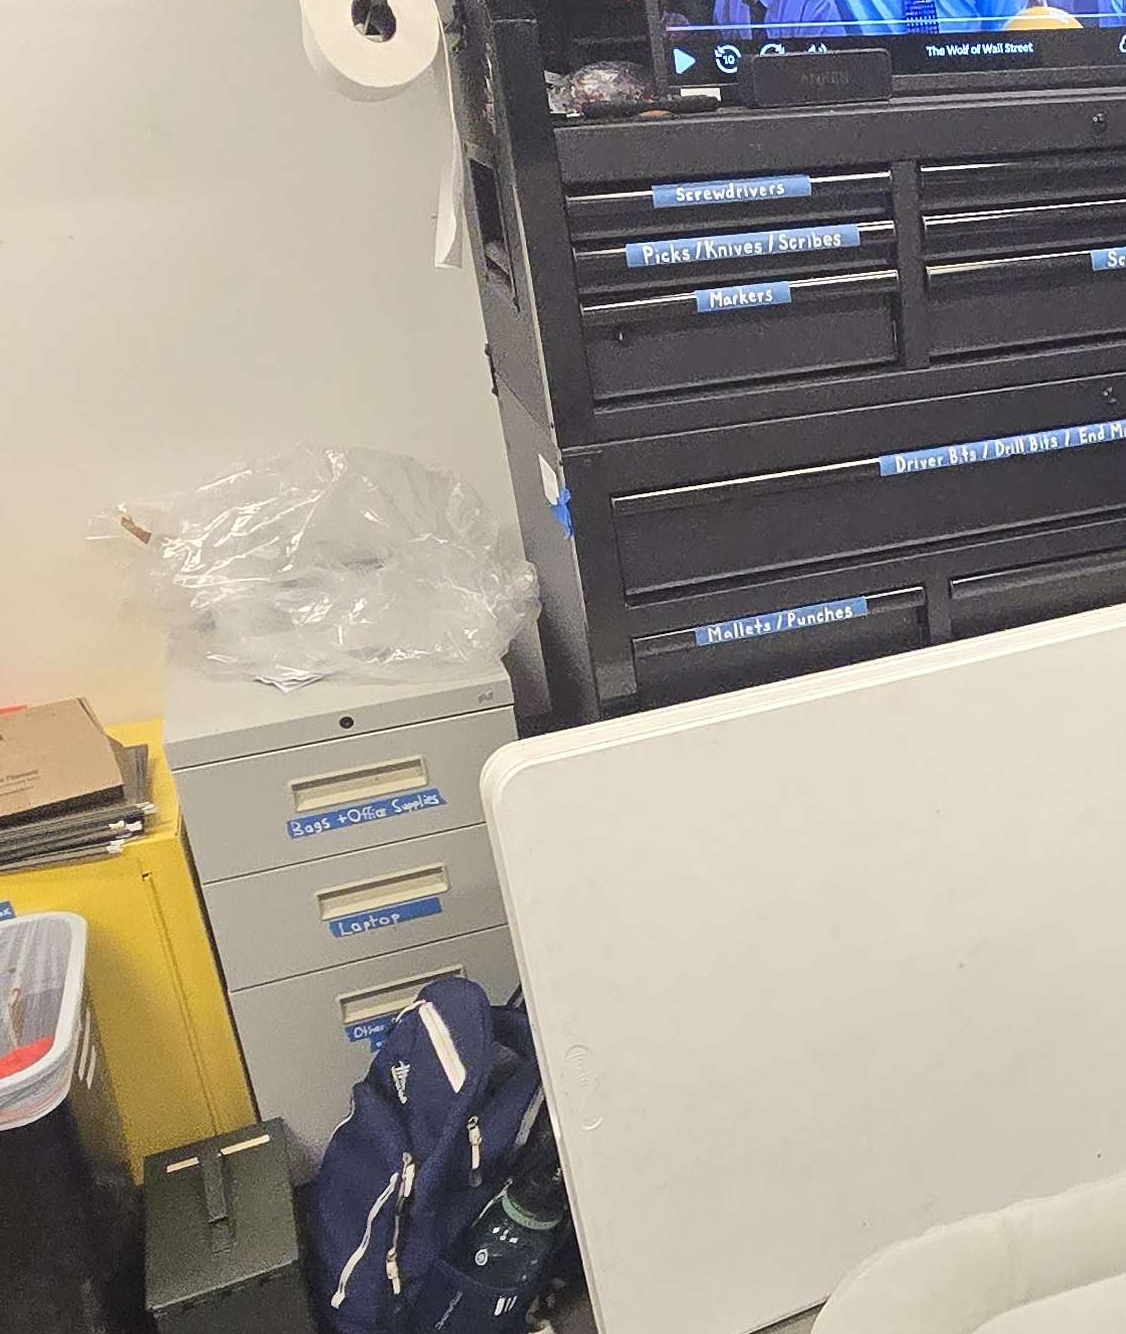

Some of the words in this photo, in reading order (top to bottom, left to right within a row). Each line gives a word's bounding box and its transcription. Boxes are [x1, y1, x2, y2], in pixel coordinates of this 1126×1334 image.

[925, 45, 946, 57] The
[946, 43, 970, 56] Wolf
[971, 43, 981, 55] of
[982, 43, 1003, 55] Wall
[1005, 42, 1034, 54] Street
[675, 182, 786, 202] Screwdrivers
[642, 245, 691, 265] Picks
[704, 240, 763, 258] Knives
[778, 231, 842, 251] Scribes
[709, 287, 773, 309] Markers
[895, 455, 944, 473] Driver
[949, 449, 977, 465] Bits
[995, 435, 1025, 457] Drill
[1029, 436, 1058, 452] Bits
[1079, 426, 1105, 443] End
[706, 618, 771, 643] Mallets
[787, 606, 853, 627] Punches
[291, 818, 331, 837] Bags
[391, 794, 440, 814] Supplies
[338, 913, 401, 936] Laptop
